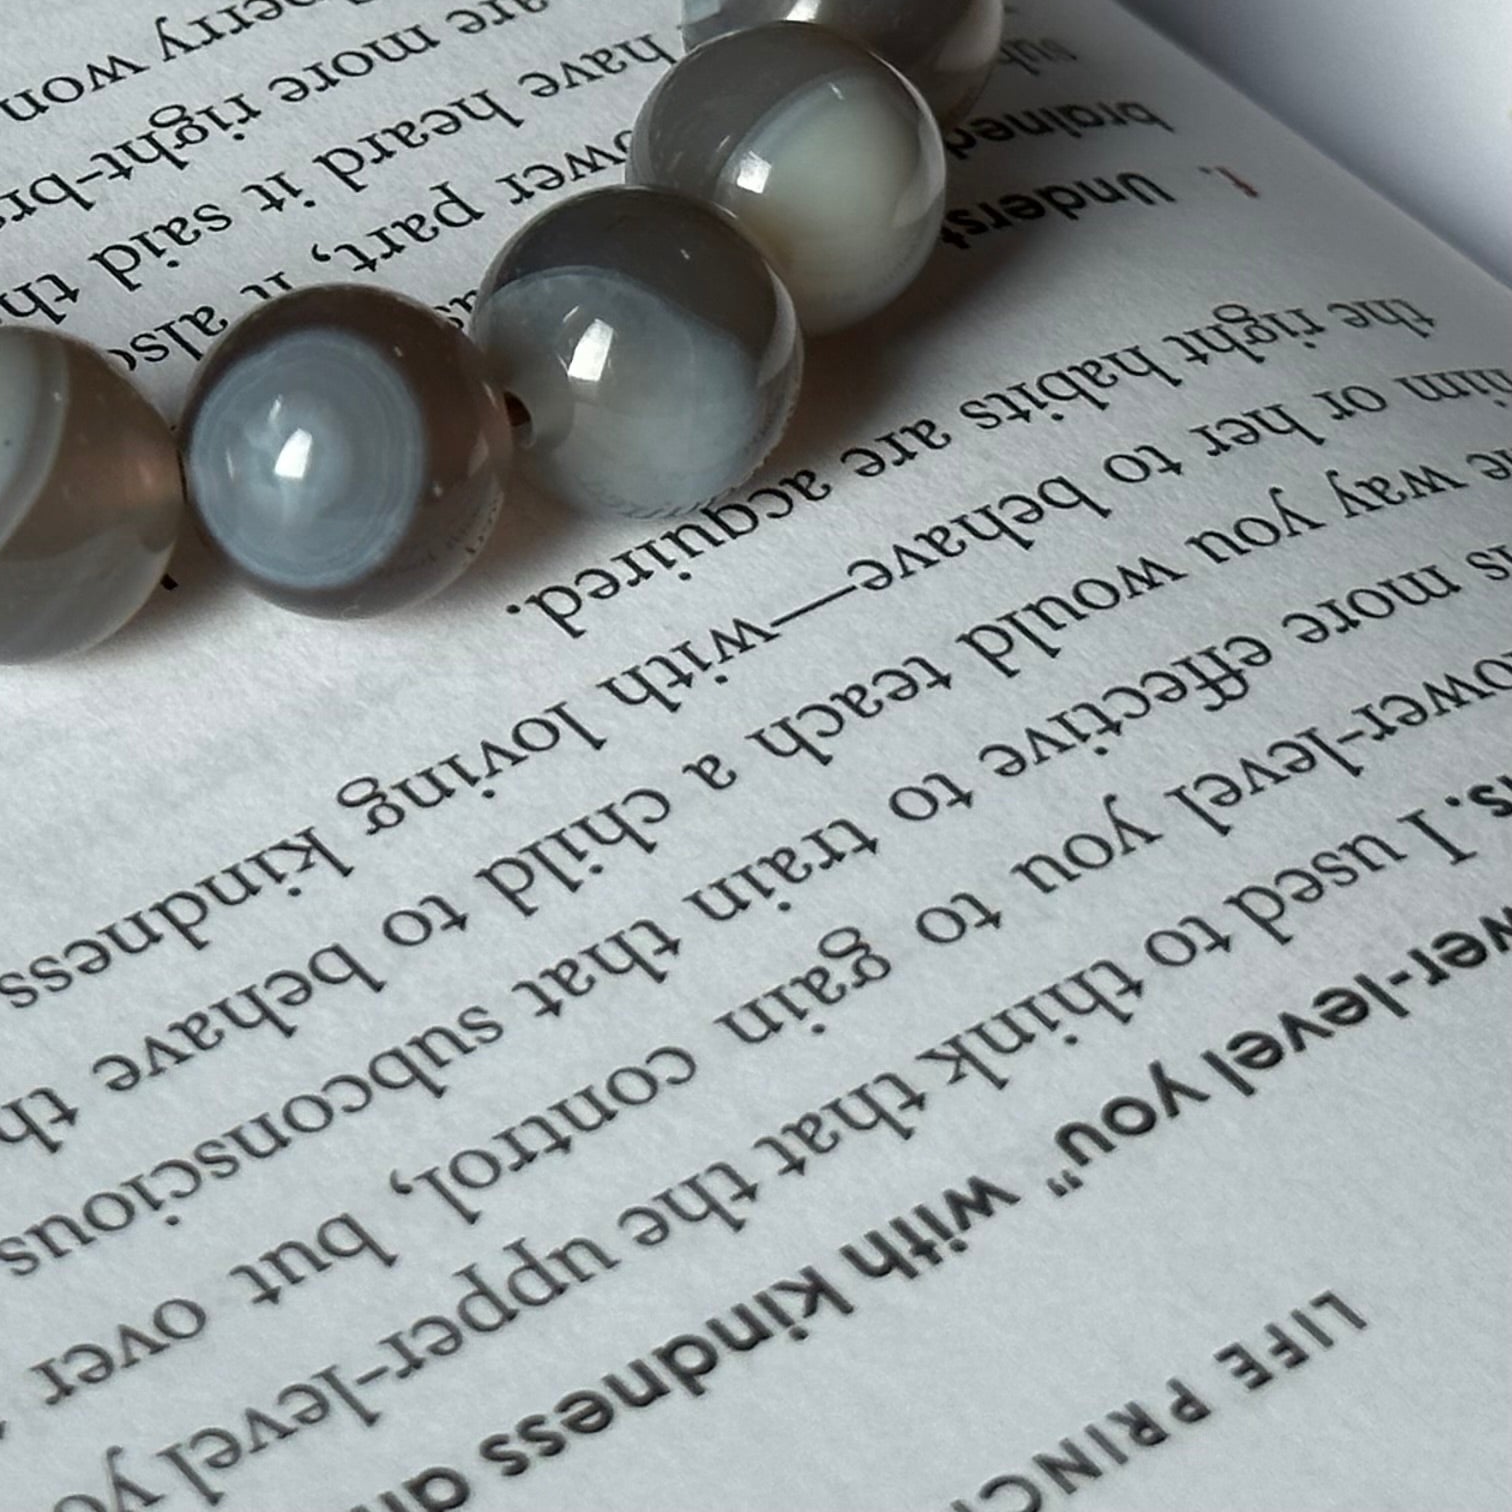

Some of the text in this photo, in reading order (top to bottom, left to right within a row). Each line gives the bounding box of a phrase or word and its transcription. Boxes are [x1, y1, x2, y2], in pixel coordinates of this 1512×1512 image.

[268, 24, 440, 102] more
[518, 34, 677, 97] have
[312, 89, 525, 193] heard
[241, 171, 304, 212] it
[311, 181, 485, 272] part,
[87, 204, 232, 292] said
[1188, 404, 1326, 457] her
[1312, 386, 1388, 421] or
[506, 299, 1435, 639] the right habits are acquired.
[1103, 445, 1184, 484] to
[1325, 465, 1470, 519] way
[1184, 487, 1327, 564] you
[955, 557, 1189, 679] would
[1281, 565, 1463, 644] more
[744, 656, 952, 766] teach
[979, 636, 1273, 777] effective
[336, 701, 607, 836] loving
[682, 754, 738, 791] a
[889, 773, 973, 821] to
[474, 789, 671, 918] child
[682, 819, 878, 922] train
[1010, 794, 1164, 894] you
[1396, 809, 1478, 866] I
[382, 895, 468, 947] to
[916, 893, 1002, 945] to
[1223, 834, 1408, 946] used
[511, 920, 681, 1018] that
[713, 926, 892, 1044] gain
[1144, 916, 1232, 967] to
[92, 944, 387, 1092] behave
[915, 960, 1144, 1091] think
[390, 1047, 697, 1225] control,
[753, 1073, 926, 1176] that
[1046, 1059, 1211, 1198] you”
[618, 1162, 758, 1247] the
[839, 1176, 1021, 1280] with
[229, 1213, 398, 1305] but
[30, 1299, 207, 1406] over
[156, 1238, 621, 1507] upper-level
[479, 1266, 855, 1478] kindness
[951, 1291, 1367, 1512] LIFE PRINC
